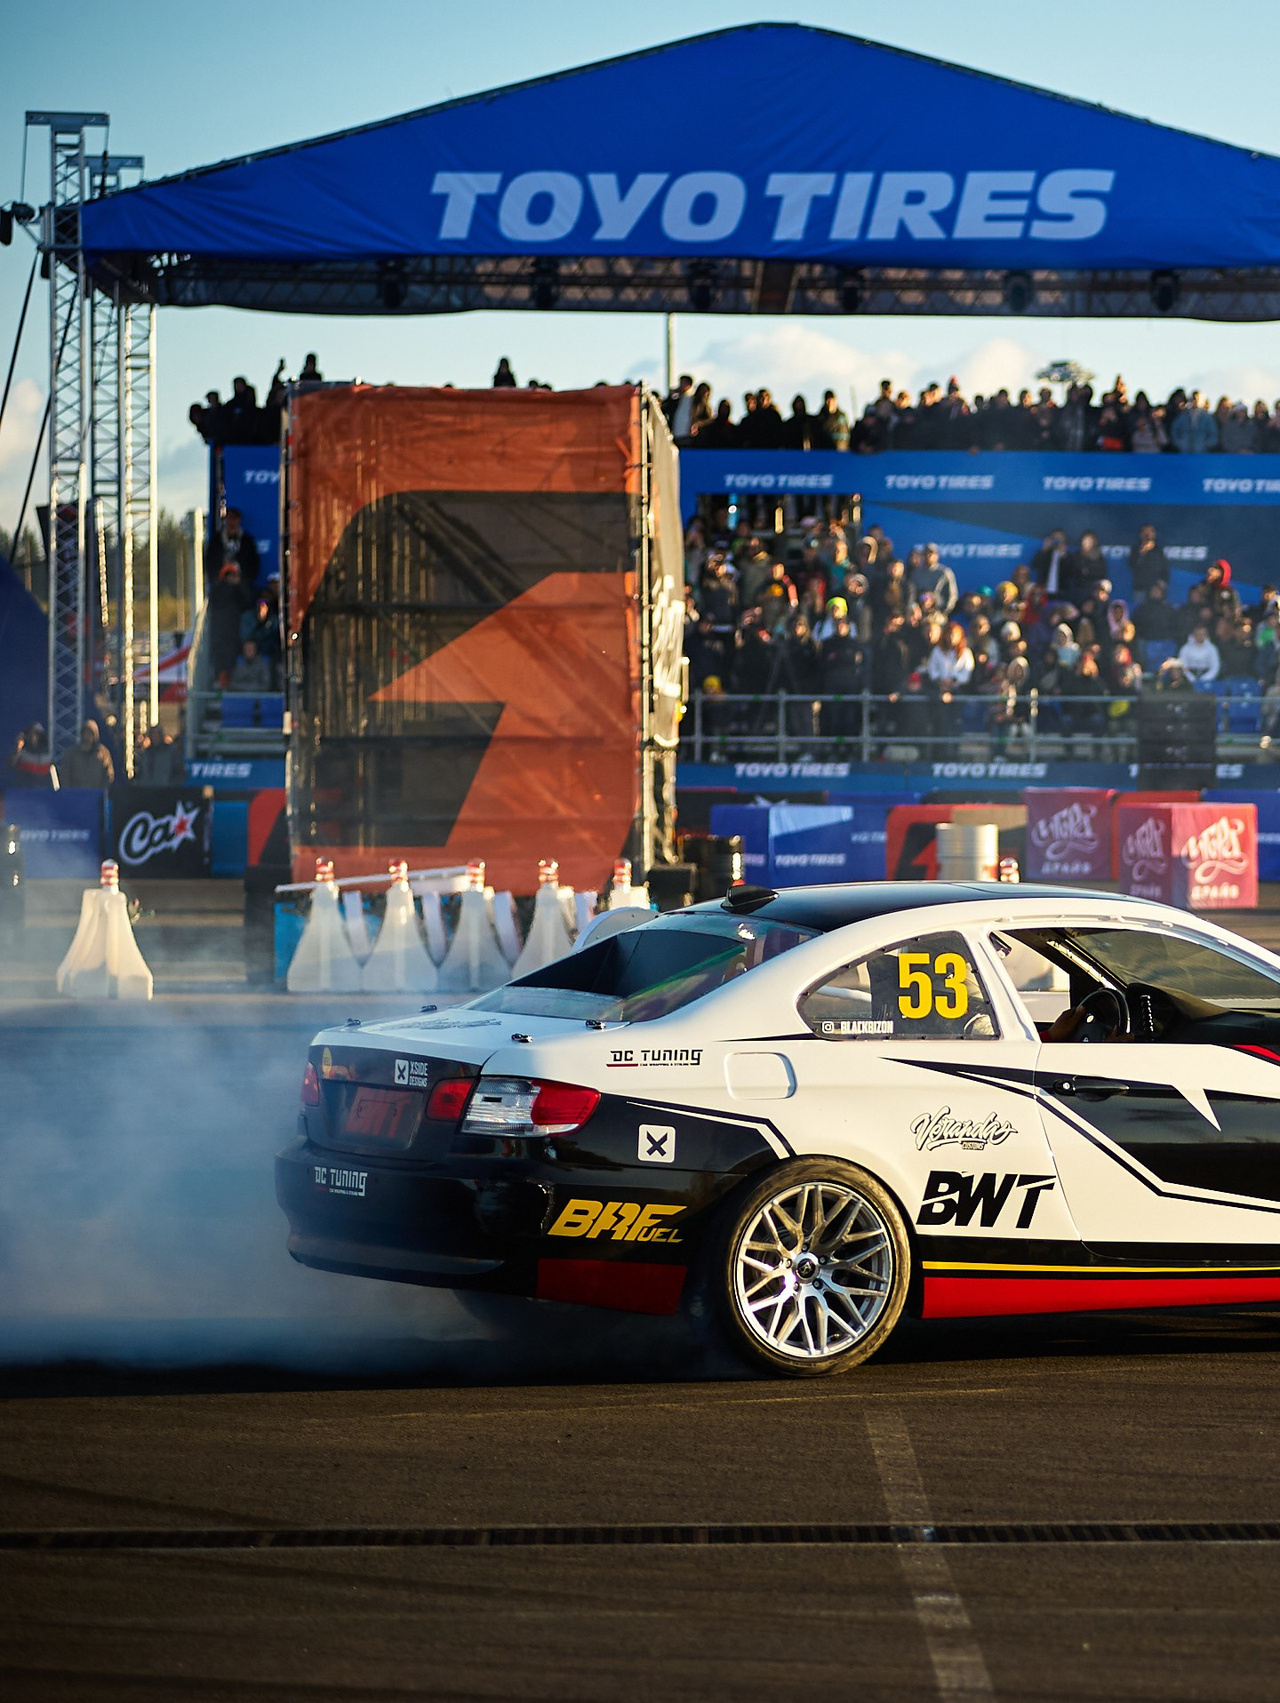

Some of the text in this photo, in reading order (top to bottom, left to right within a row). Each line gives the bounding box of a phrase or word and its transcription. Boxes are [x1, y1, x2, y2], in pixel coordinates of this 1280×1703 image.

[430, 168, 1116, 242] TOYO TIRES
[245, 470, 280, 484] TOY
[724, 474, 834, 488] TOYO TIRES
[885, 475, 994, 490] TOYO TIRES
[1043, 476, 1151, 491] TOYO TIRES
[1202, 478, 1253, 492] TOYO
[191, 763, 252, 777] TIRES
[735, 762, 850, 777] TOYO TIRES
[932, 762, 1047, 777] TOYO TIRES
[898, 952, 969, 1019] 53
[841, 1020, 893, 1034] BLACKBIZON
[610, 1050, 633, 1062] DC
[315, 1166, 327, 1184] DC
[916, 1170, 1056, 1229] BWT
